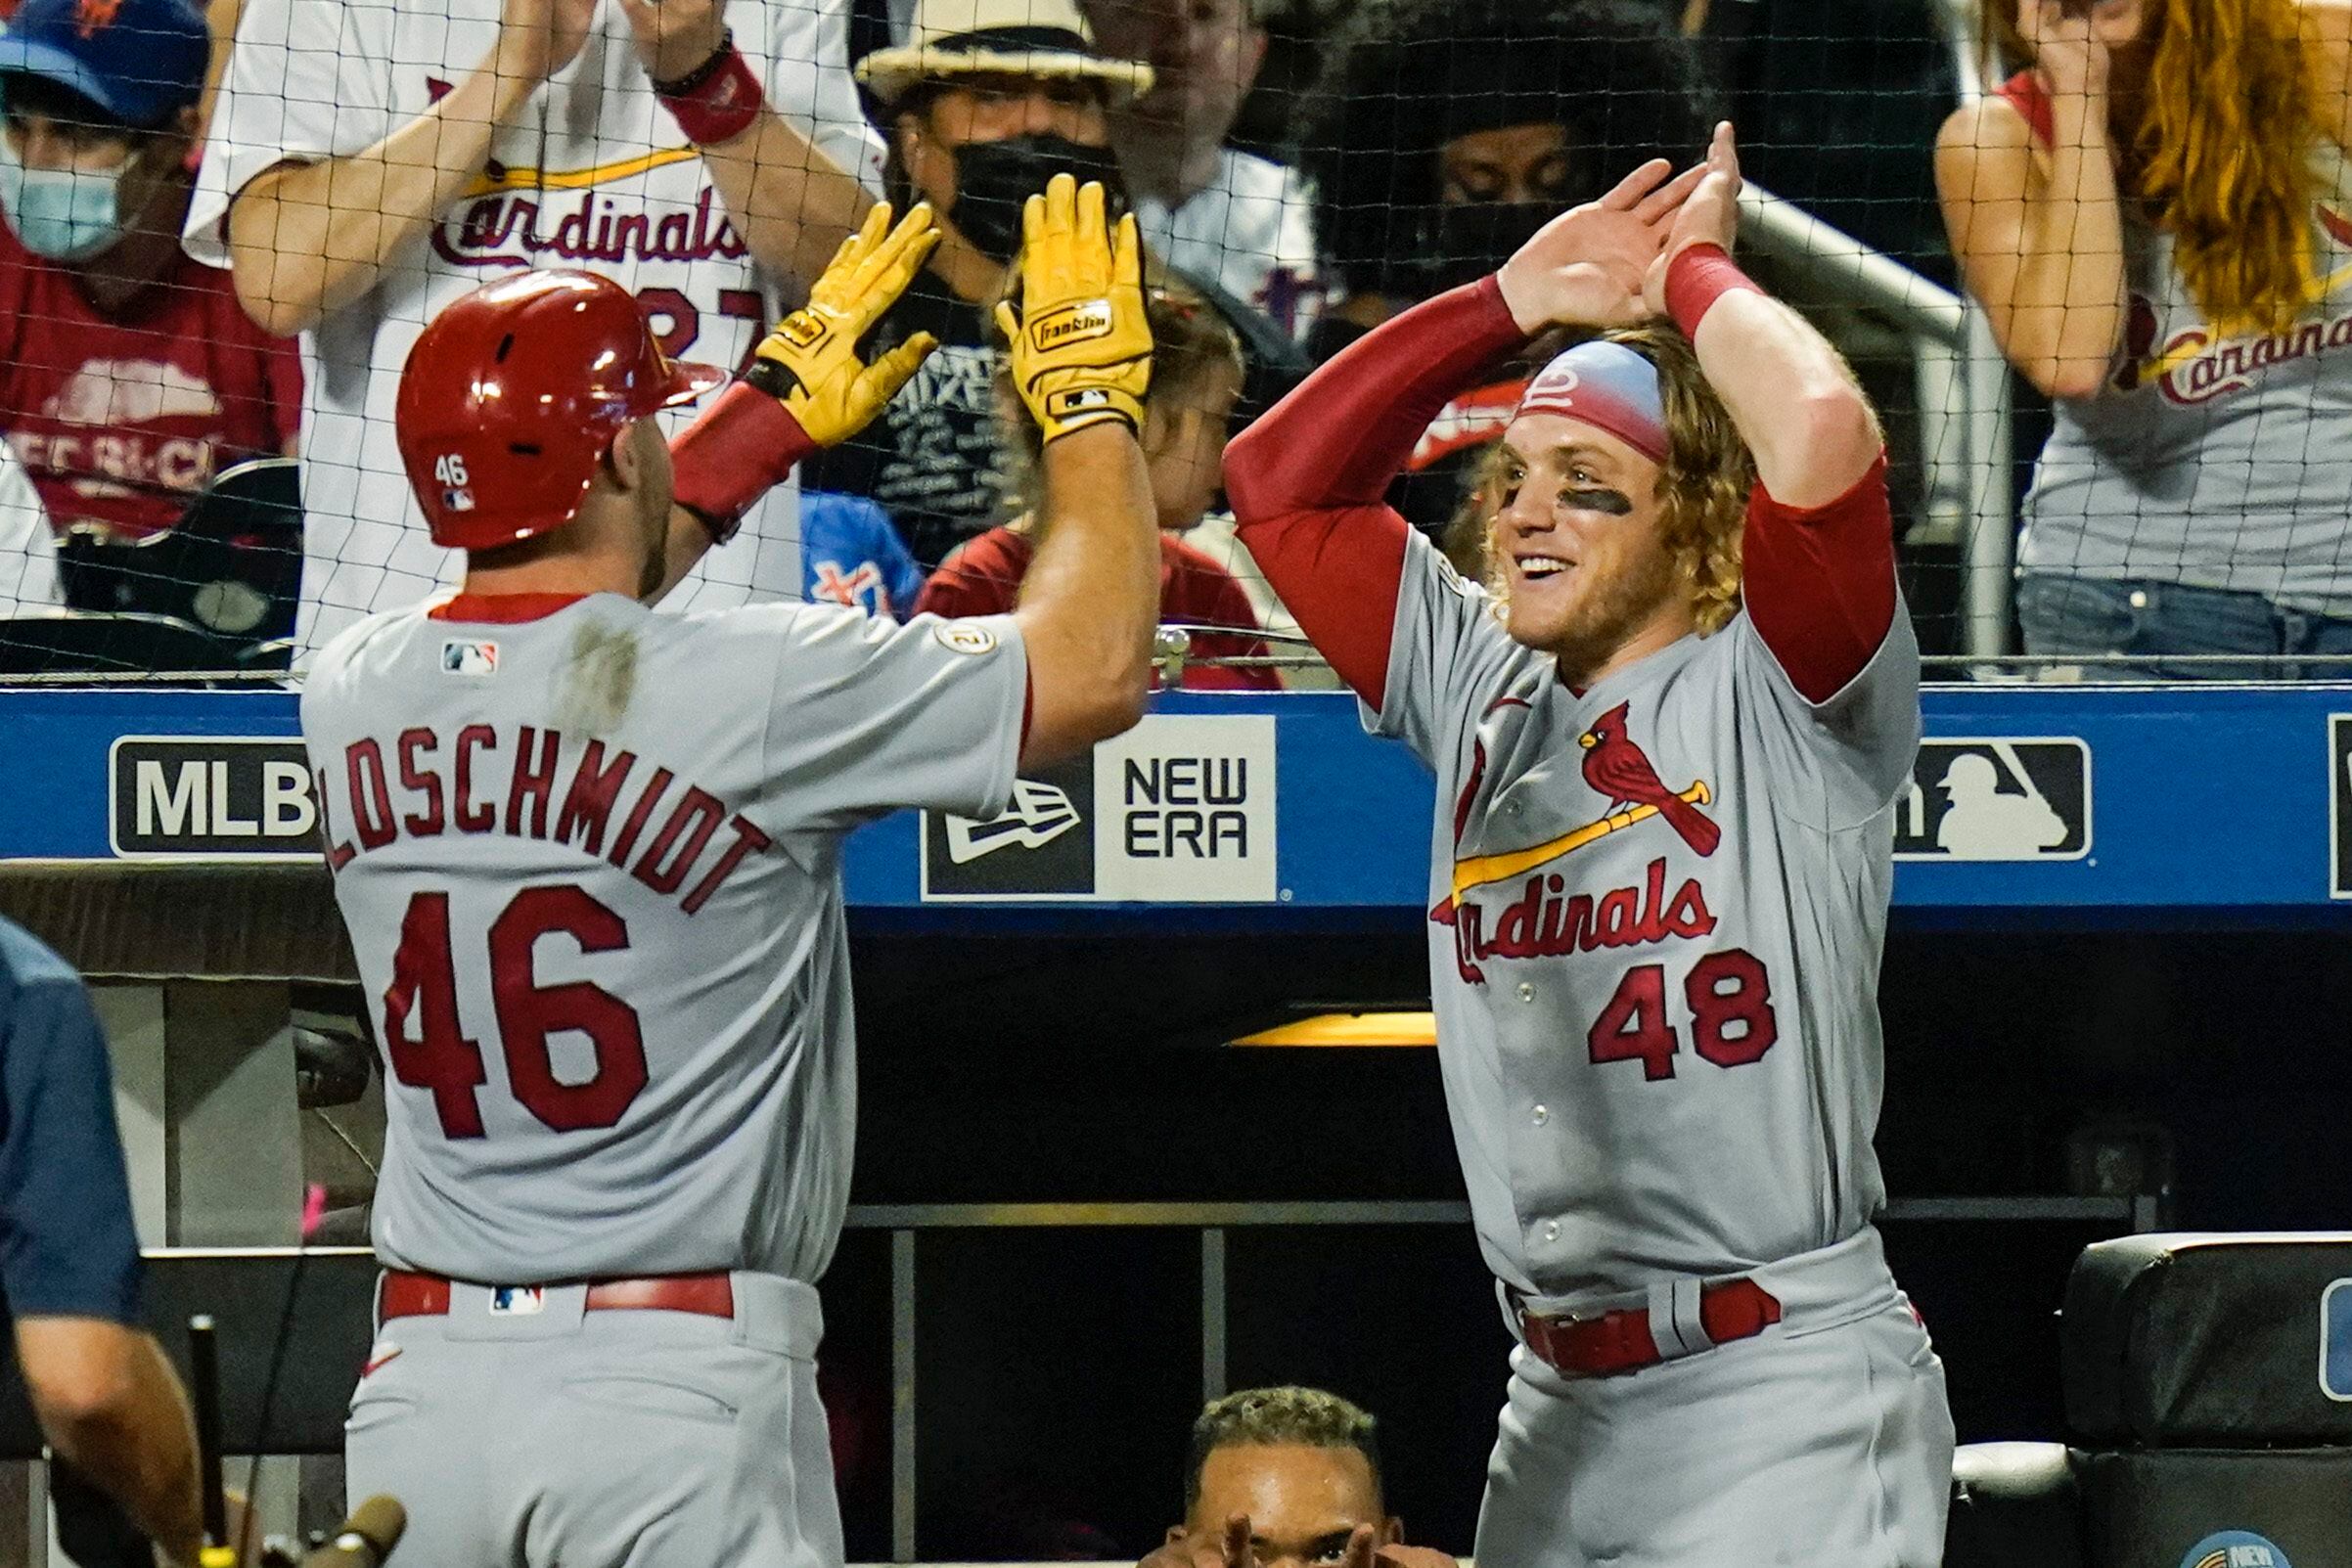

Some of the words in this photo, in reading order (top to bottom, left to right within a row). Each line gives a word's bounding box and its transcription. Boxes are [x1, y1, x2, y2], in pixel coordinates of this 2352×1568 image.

[430, 185, 750, 267] Cardinals
[435, 453, 469, 487] 46
[318, 724, 772, 916] LDSCHMIDT
[1124, 758, 1246, 805] NEW
[1124, 811, 1247, 858] ERA
[1455, 856, 1718, 978] rdinals
[384, 884, 650, 1140] 46
[1587, 947, 1779, 1082] 48
